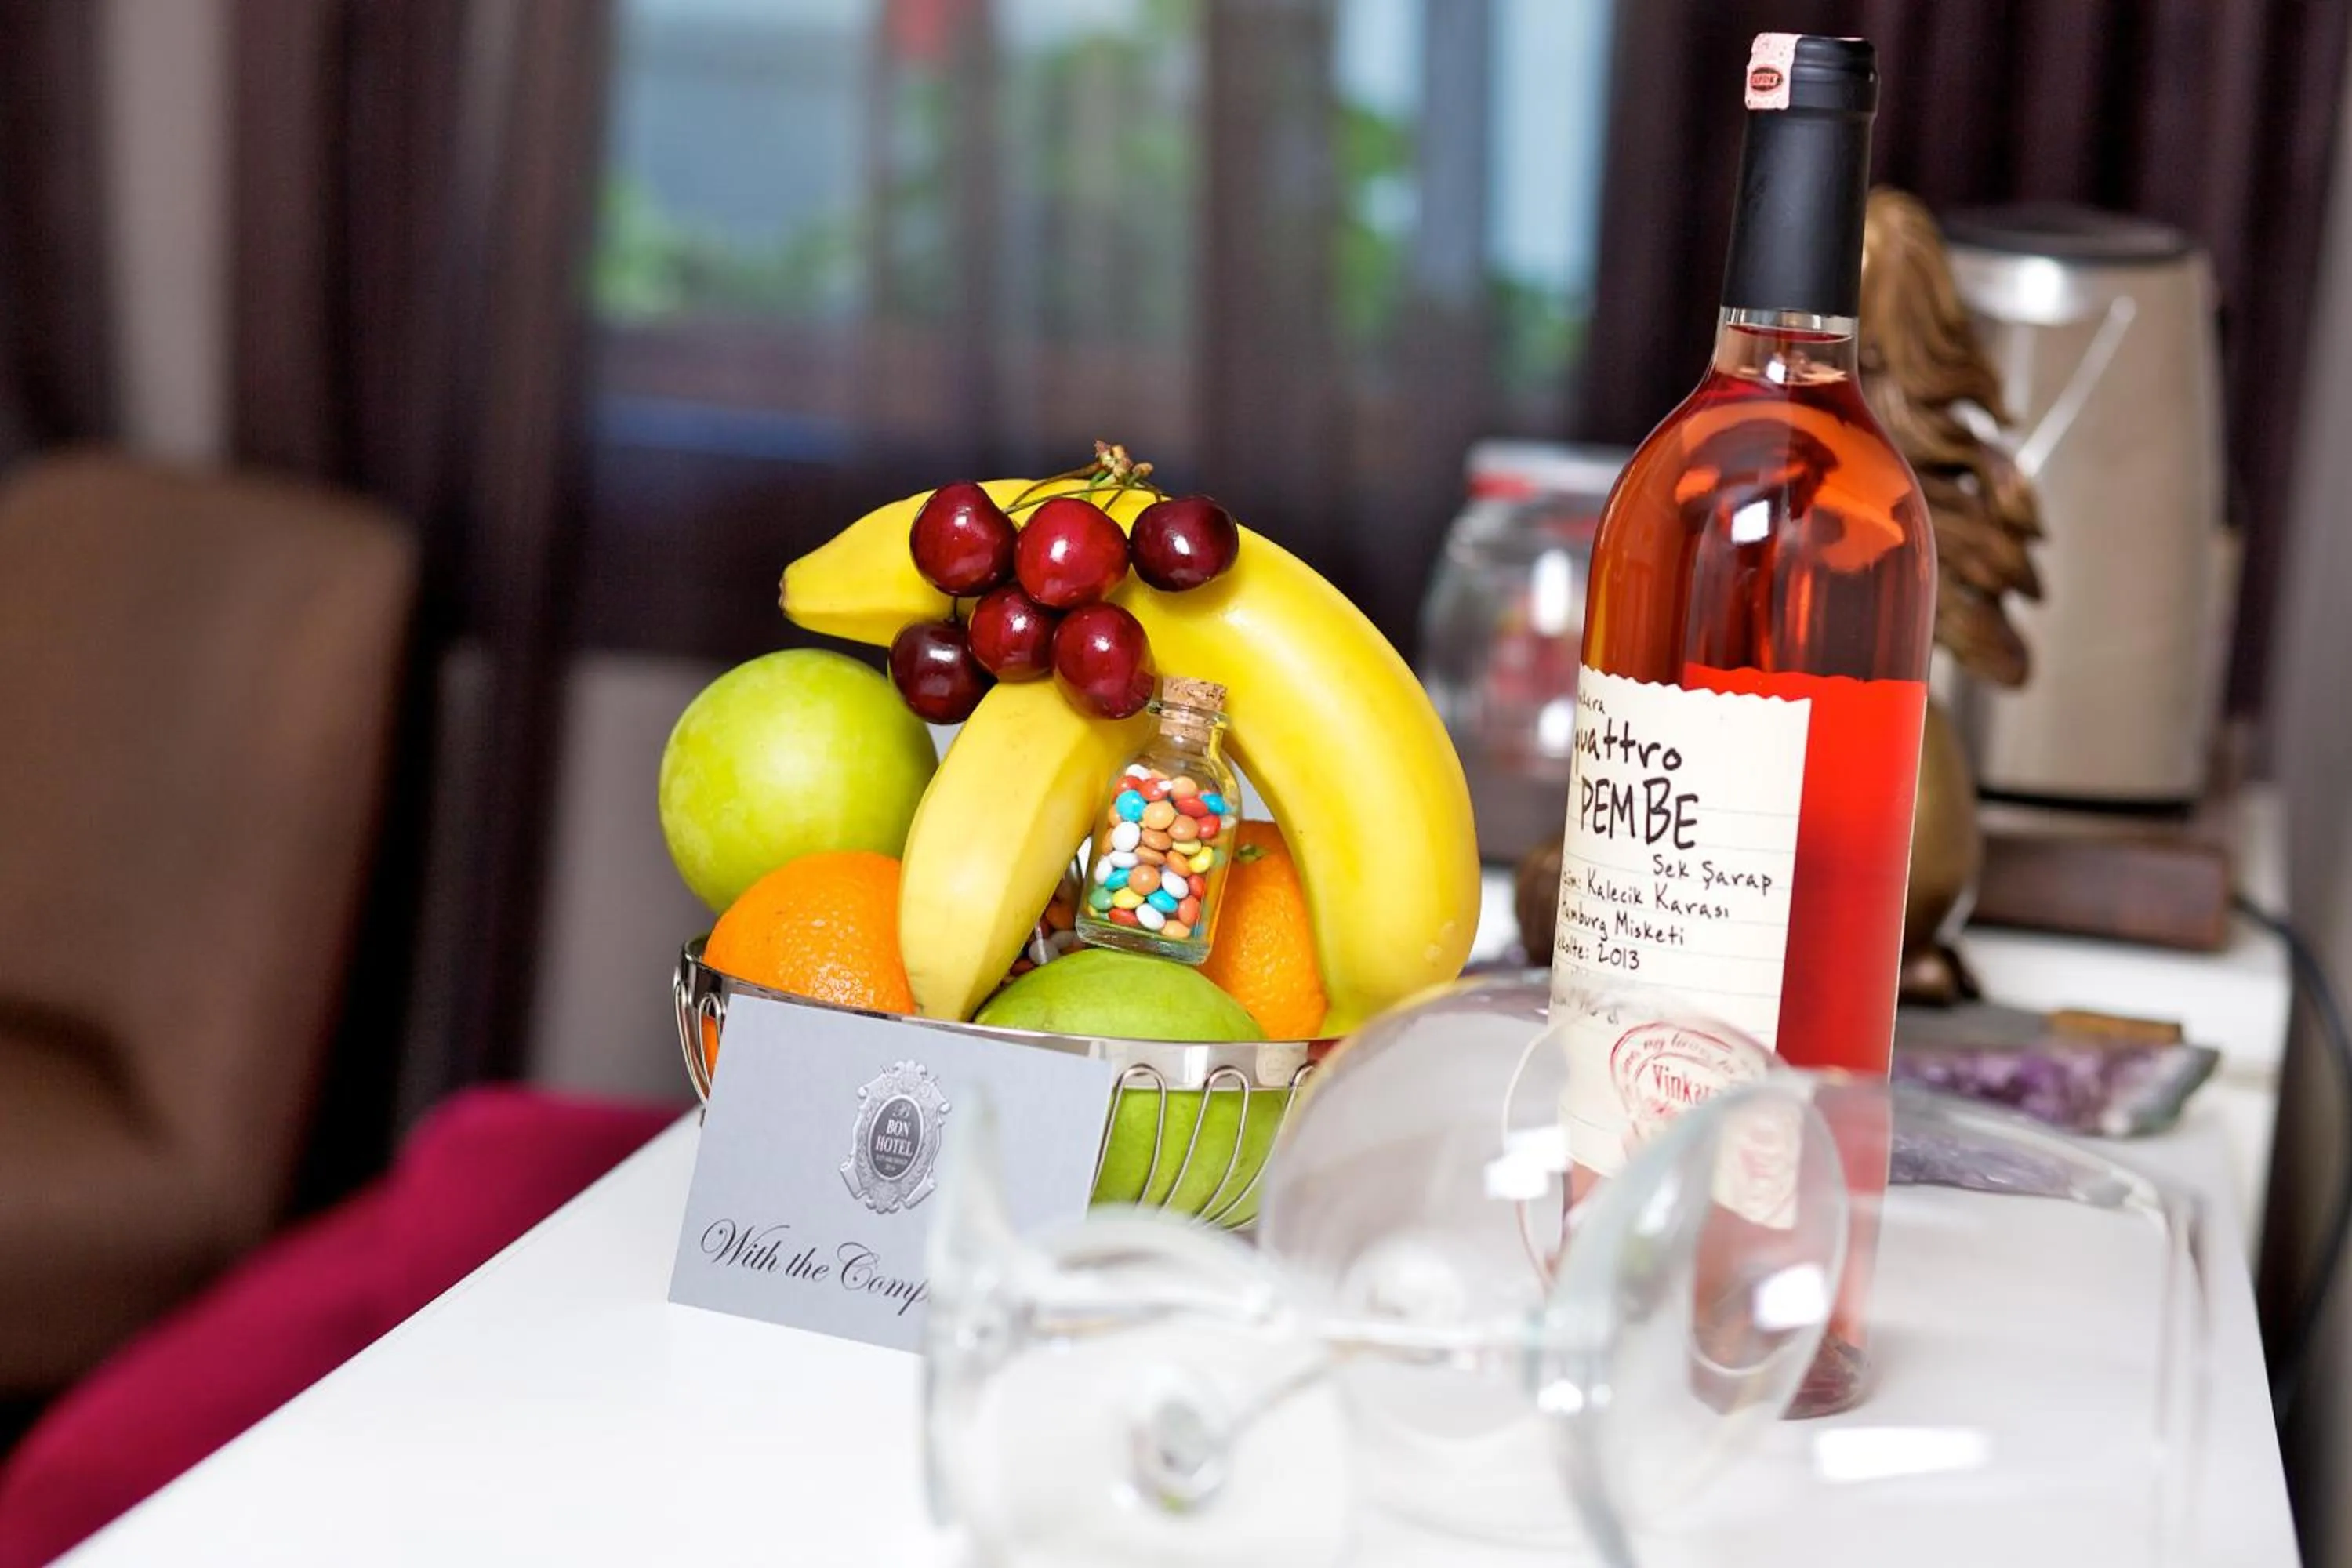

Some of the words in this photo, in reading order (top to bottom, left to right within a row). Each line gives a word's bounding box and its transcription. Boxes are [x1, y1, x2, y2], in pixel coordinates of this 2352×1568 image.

[1580, 776, 1699, 850] PEMBE
[1587, 866, 1644, 906] Kalecik
[1654, 883, 1730, 920] Karası
[1653, 853, 1690, 878] Sek
[1701, 860, 1773, 897] Şarap
[1614, 910, 1685, 946] Misketi
[1597, 942, 1641, 971] 2013
[1652, 1063, 1720, 1105] Vinkar
[875, 1134, 913, 1158] HOTEL
[886, 1119, 911, 1138] BON
[700, 1218, 791, 1269] With
[784, 1247, 830, 1282] the
[836, 1241, 931, 1316] Comp
